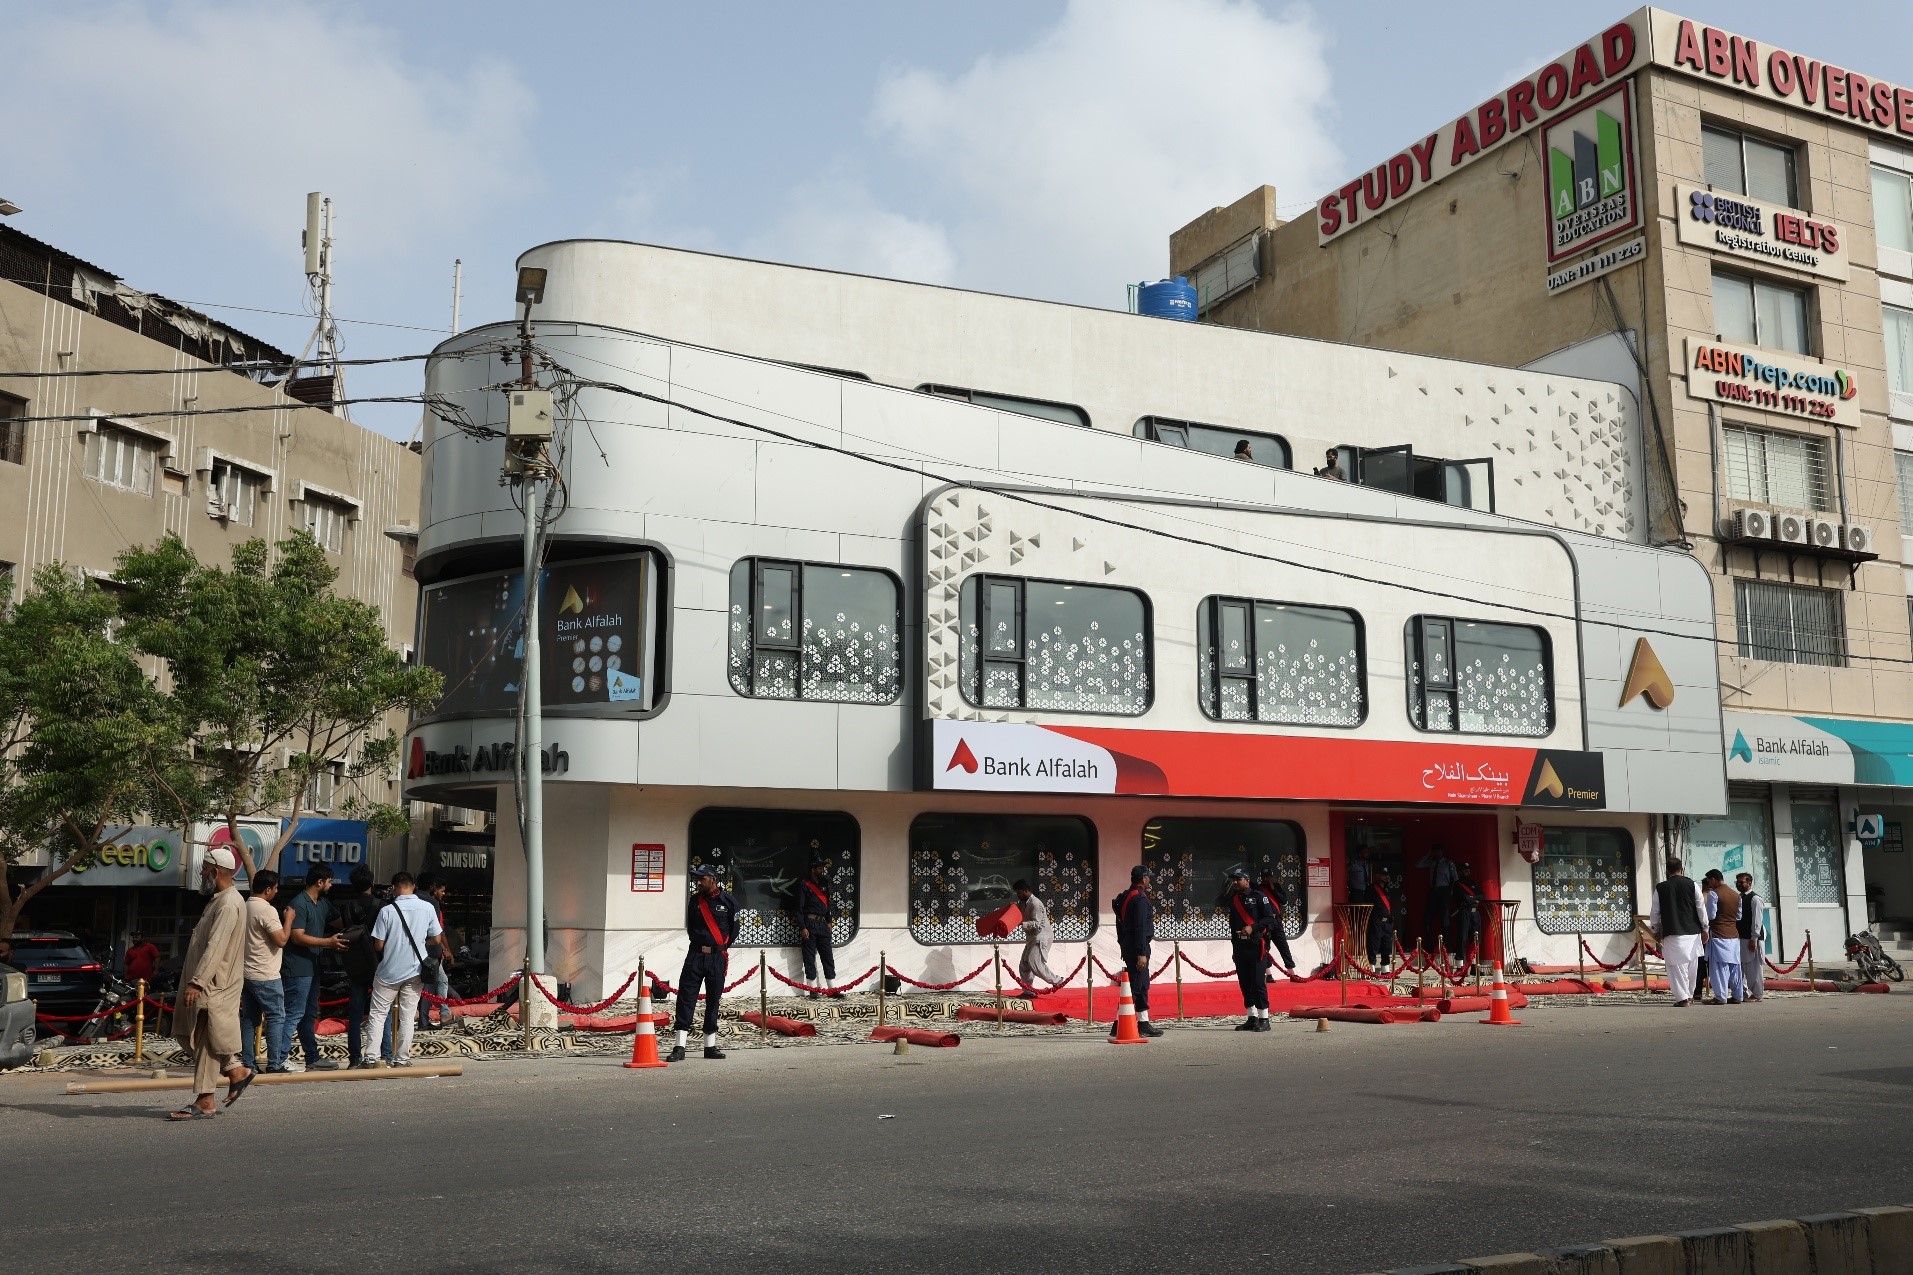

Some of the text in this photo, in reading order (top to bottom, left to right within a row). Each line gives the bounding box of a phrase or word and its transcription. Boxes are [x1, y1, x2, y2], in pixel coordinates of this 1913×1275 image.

[1675, 19, 1913, 136] ABN OVERSE
[1320, 22, 1636, 236] STUDY ABROAD
[1556, 163, 1621, 217] ABN
[1557, 194, 1626, 233] OVERSEAS
[1716, 197, 1761, 220] BRITISH
[1716, 211, 1765, 235] COUNCIL
[1558, 207, 1626, 246] EDUCATION
[1775, 213, 1840, 253] IELTS
[1717, 229, 1820, 266] Registration Centre
[1548, 242, 1641, 290] UAN: 111 111 226
[1695, 345, 1838, 396] ABNPrep.com
[1716, 380, 1836, 418] UAN: 111 111 226
[556, 634, 579, 642] Premier
[557, 614, 622, 632] Bank Alfalah
[1756, 737, 1829, 757] Bank Alfalah
[983, 756, 1098, 779] Bank Alfalah
[1422, 761, 1465, 789] الفلاح
[1568, 787, 1599, 800] Premier
[1520, 826, 1537, 836] CDM
[439, 851, 488, 869] SAMSUNG
